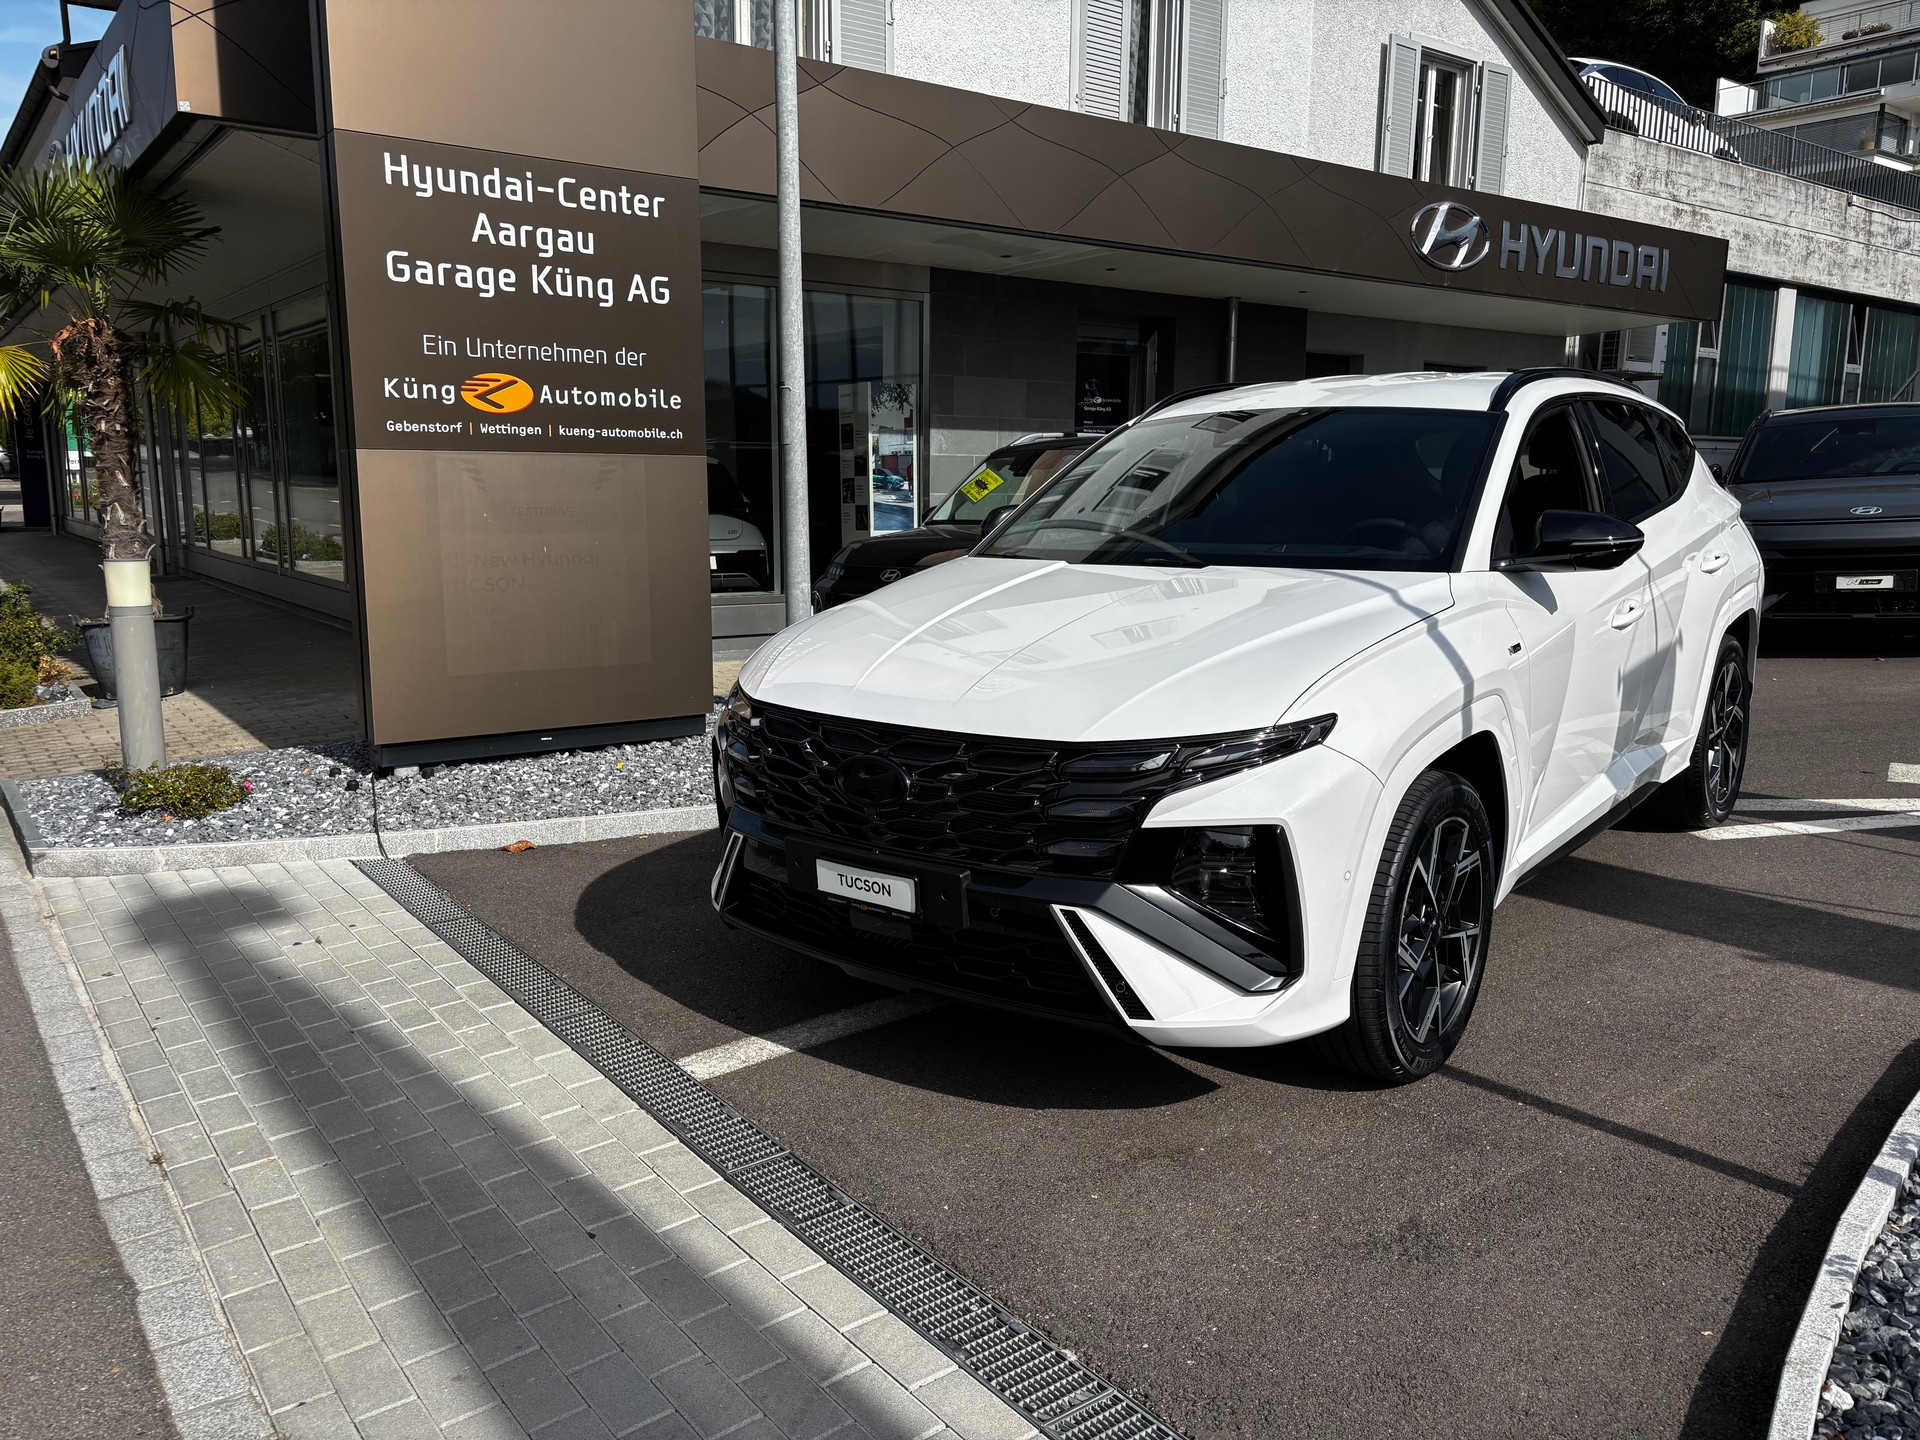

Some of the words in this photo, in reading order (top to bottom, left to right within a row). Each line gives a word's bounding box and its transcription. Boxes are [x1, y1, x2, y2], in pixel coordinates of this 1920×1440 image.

[383, 152, 666, 218] Hyundai-Center
[471, 213, 595, 258] Aargau
[1499, 219, 1671, 293] HYUNDAI
[386, 250, 517, 298] Garage
[531, 264, 614, 308] Küng
[627, 273, 670, 305] AG
[422, 334, 457, 356] Ein
[466, 337, 607, 365] Unternehmen
[615, 347, 647, 367] der
[383, 377, 456, 405] Küng
[539, 385, 682, 410] Automobile
[386, 420, 463, 434] Gebenstorf
[479, 423, 542, 440] Wettingen
[558, 425, 684, 440] kueng-automobile.ch
[837, 873, 891, 897] TUCSON
